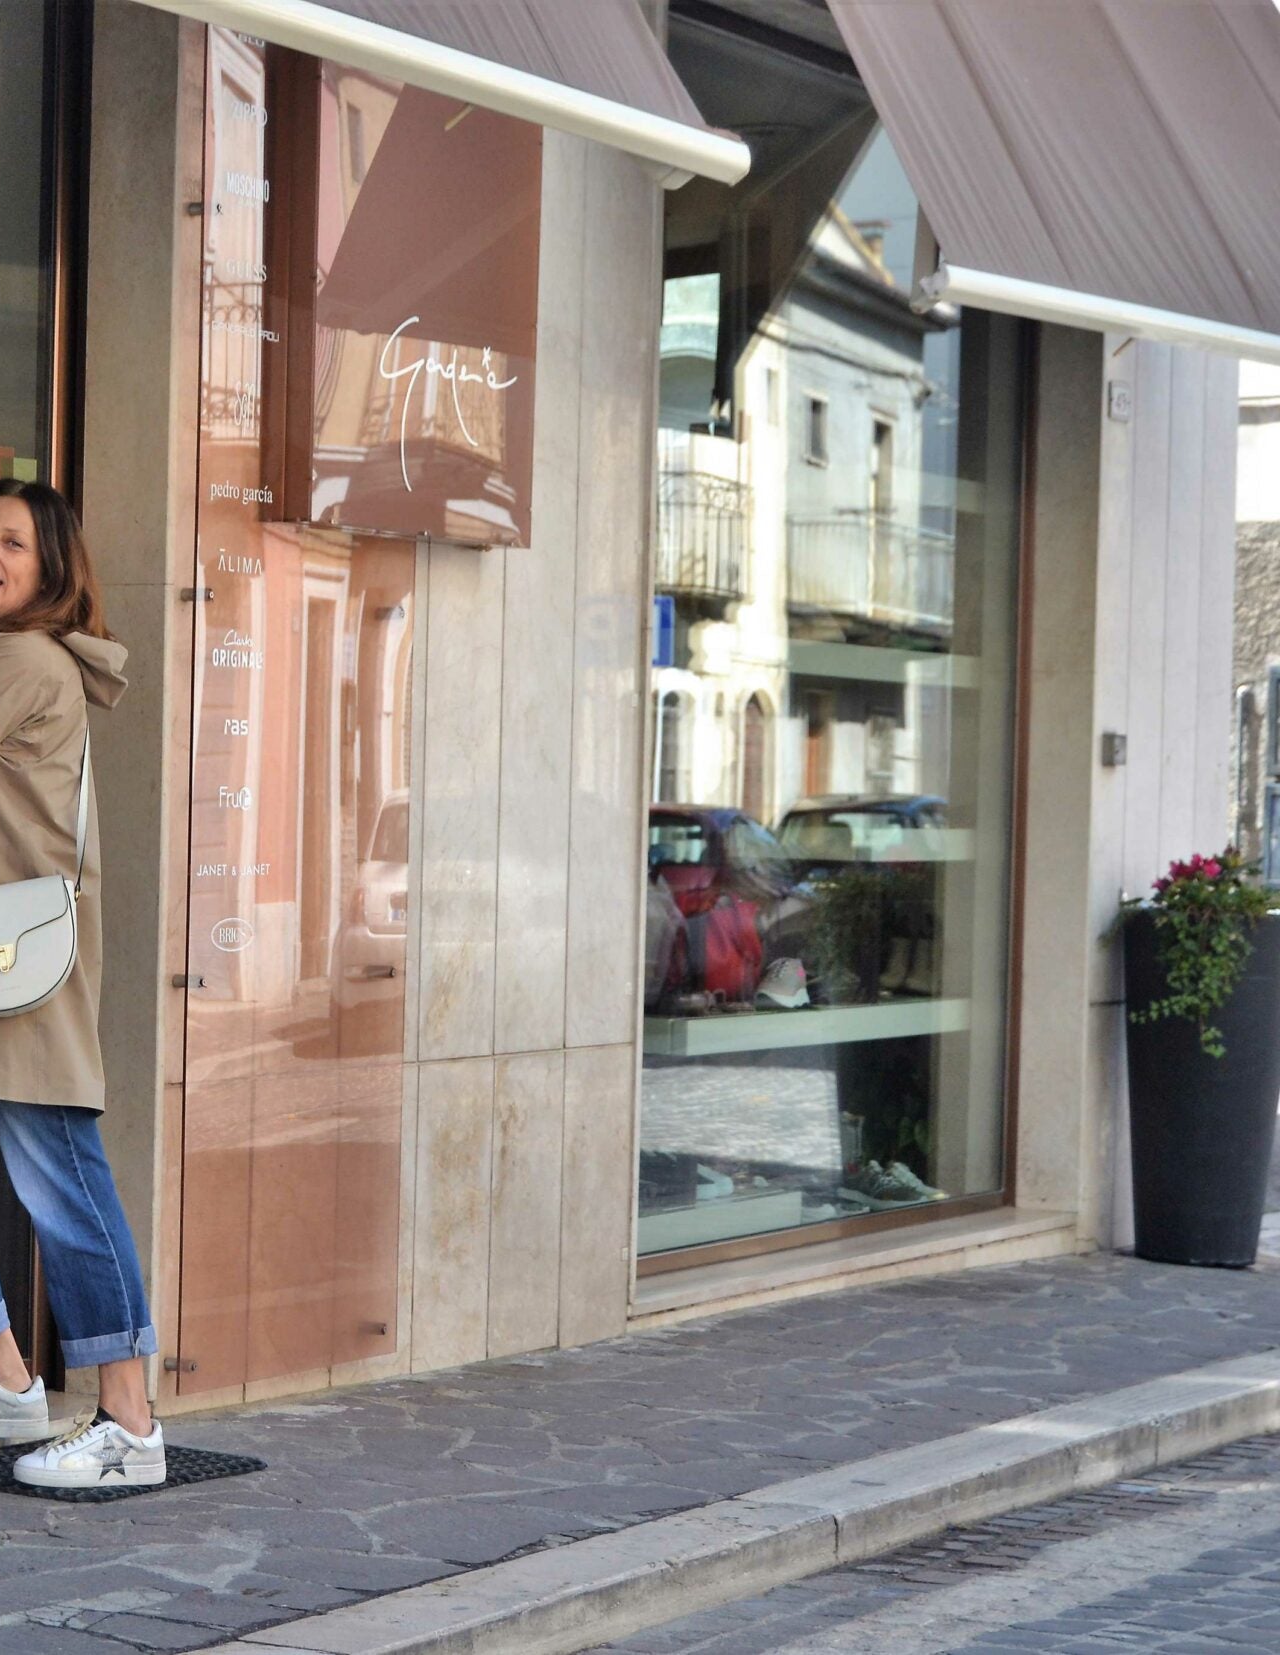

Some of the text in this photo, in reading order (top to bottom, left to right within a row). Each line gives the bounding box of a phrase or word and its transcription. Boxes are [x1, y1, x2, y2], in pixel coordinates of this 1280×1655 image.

[226, 171, 269, 203] MOSCHINO
[210, 480, 273, 505] pedro garcía
[223, 719, 249, 736] ras
[196, 863, 271, 877] JANET & JANET
